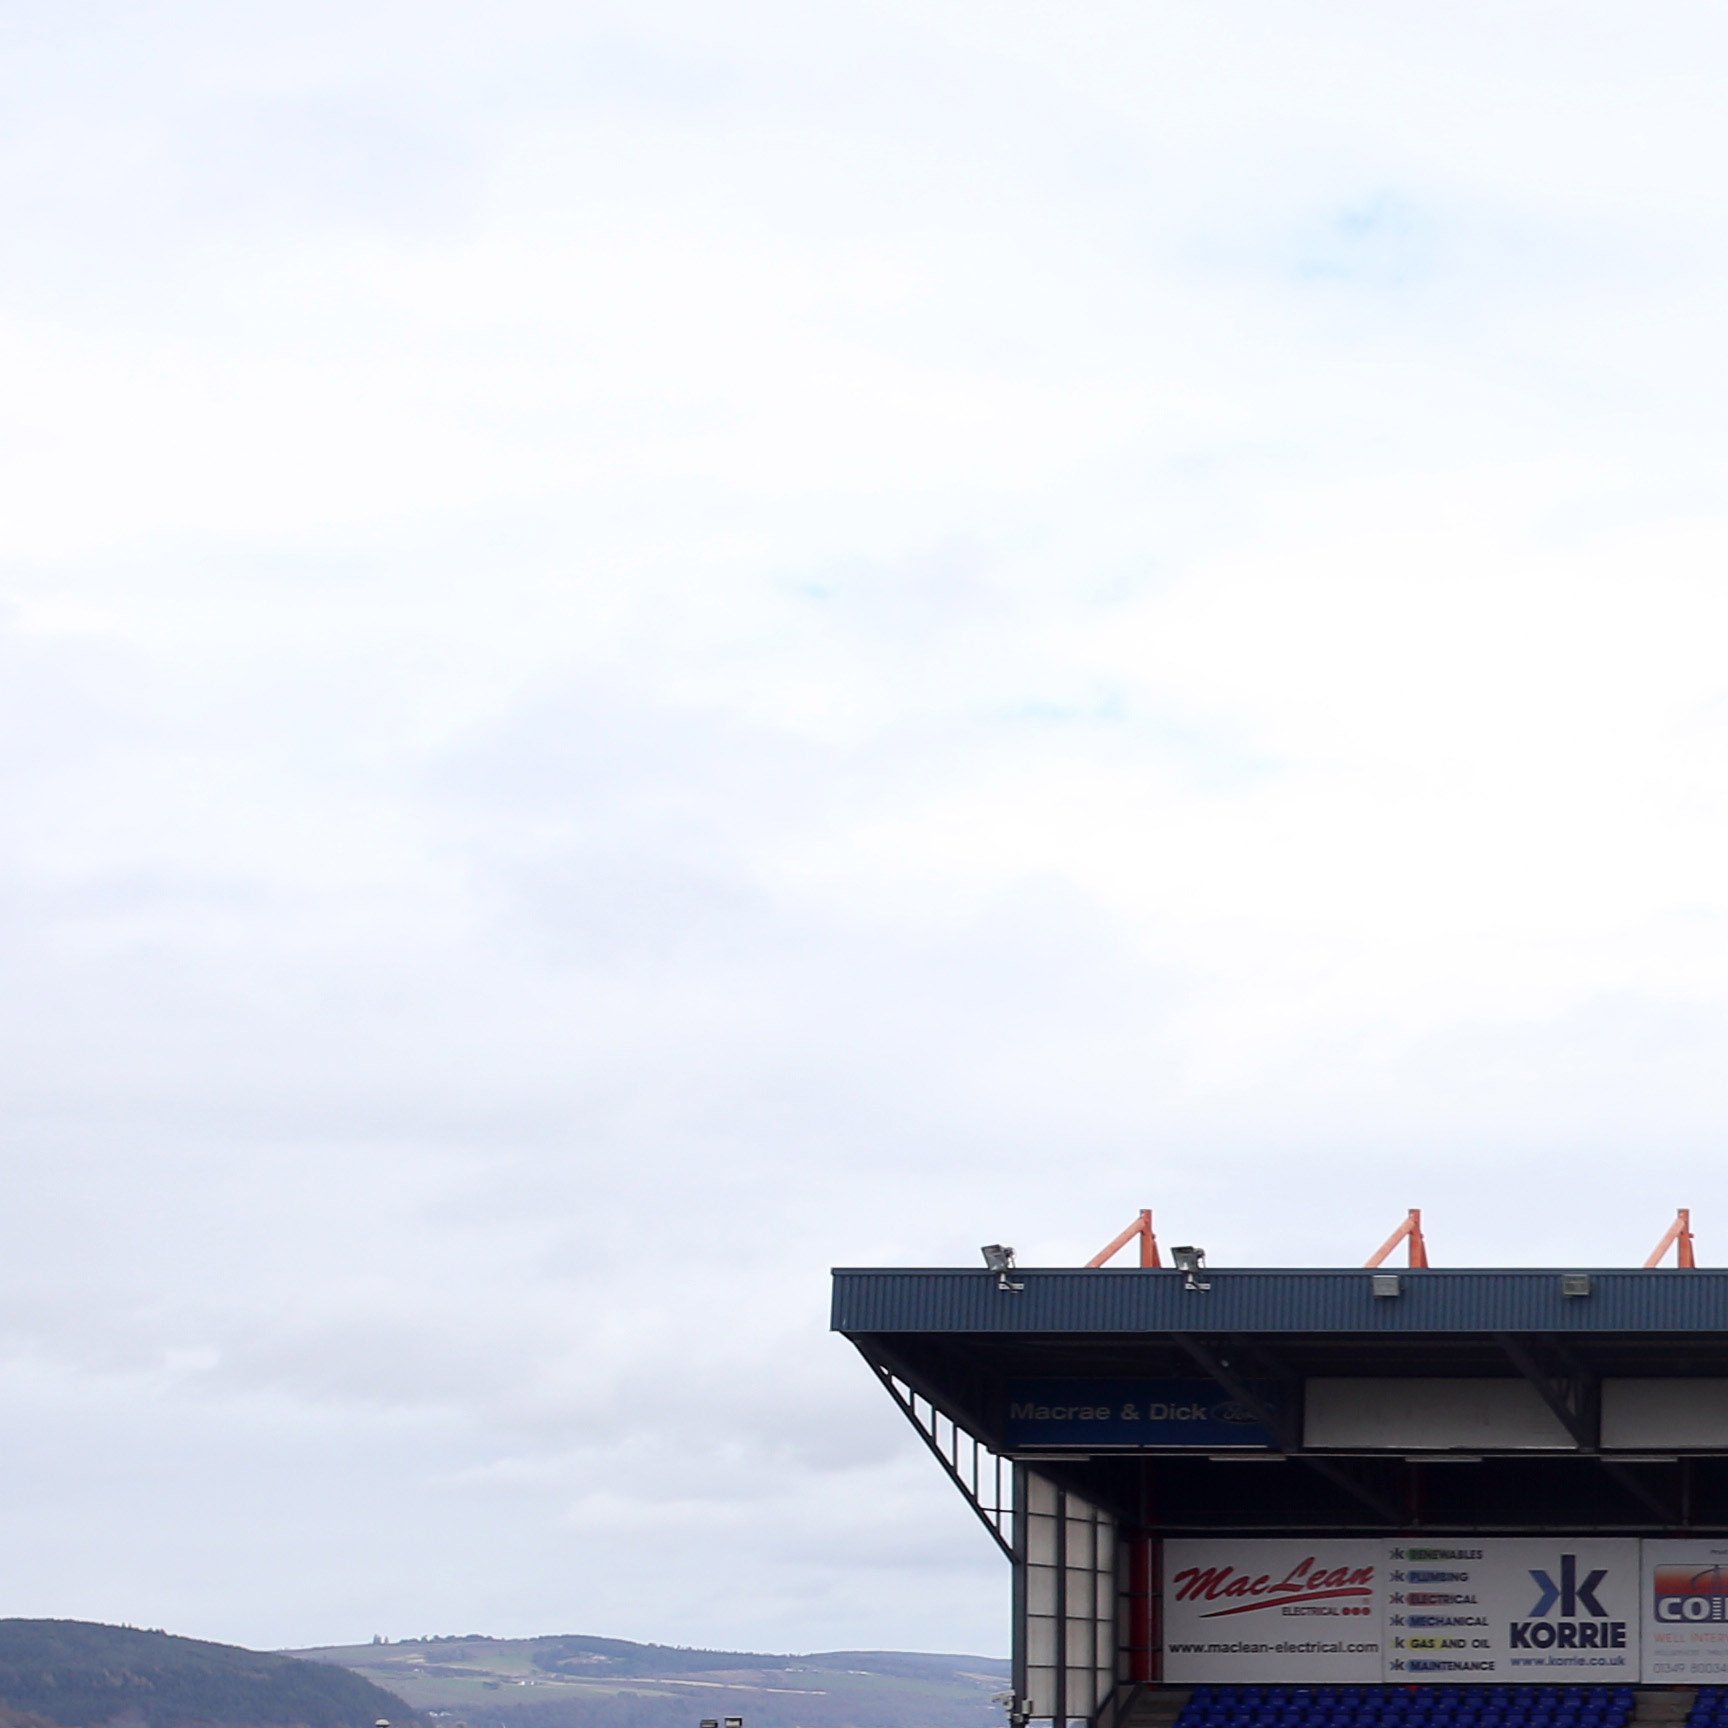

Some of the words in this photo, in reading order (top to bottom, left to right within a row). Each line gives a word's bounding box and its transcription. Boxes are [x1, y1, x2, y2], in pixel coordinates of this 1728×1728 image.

[1010, 1402, 1111, 1420] Macrae
[1119, 1402, 1140, 1420] &
[1150, 1402, 1207, 1420] Dick
[1282, 1607, 1340, 1616] ELECTRICAL
[1409, 1617, 1489, 1626] MECHANICAL
[1509, 1622, 1627, 1648] KORRIE
[1655, 1634, 1686, 1643] WELL
[1169, 1641, 1379, 1654] www.maclean-electrical.com
[1411, 1639, 1436, 1648] GAS
[1410, 1661, 1495, 1671] MAINTENANCE
[1510, 1656, 1626, 1666] www.korrie.co.uk
